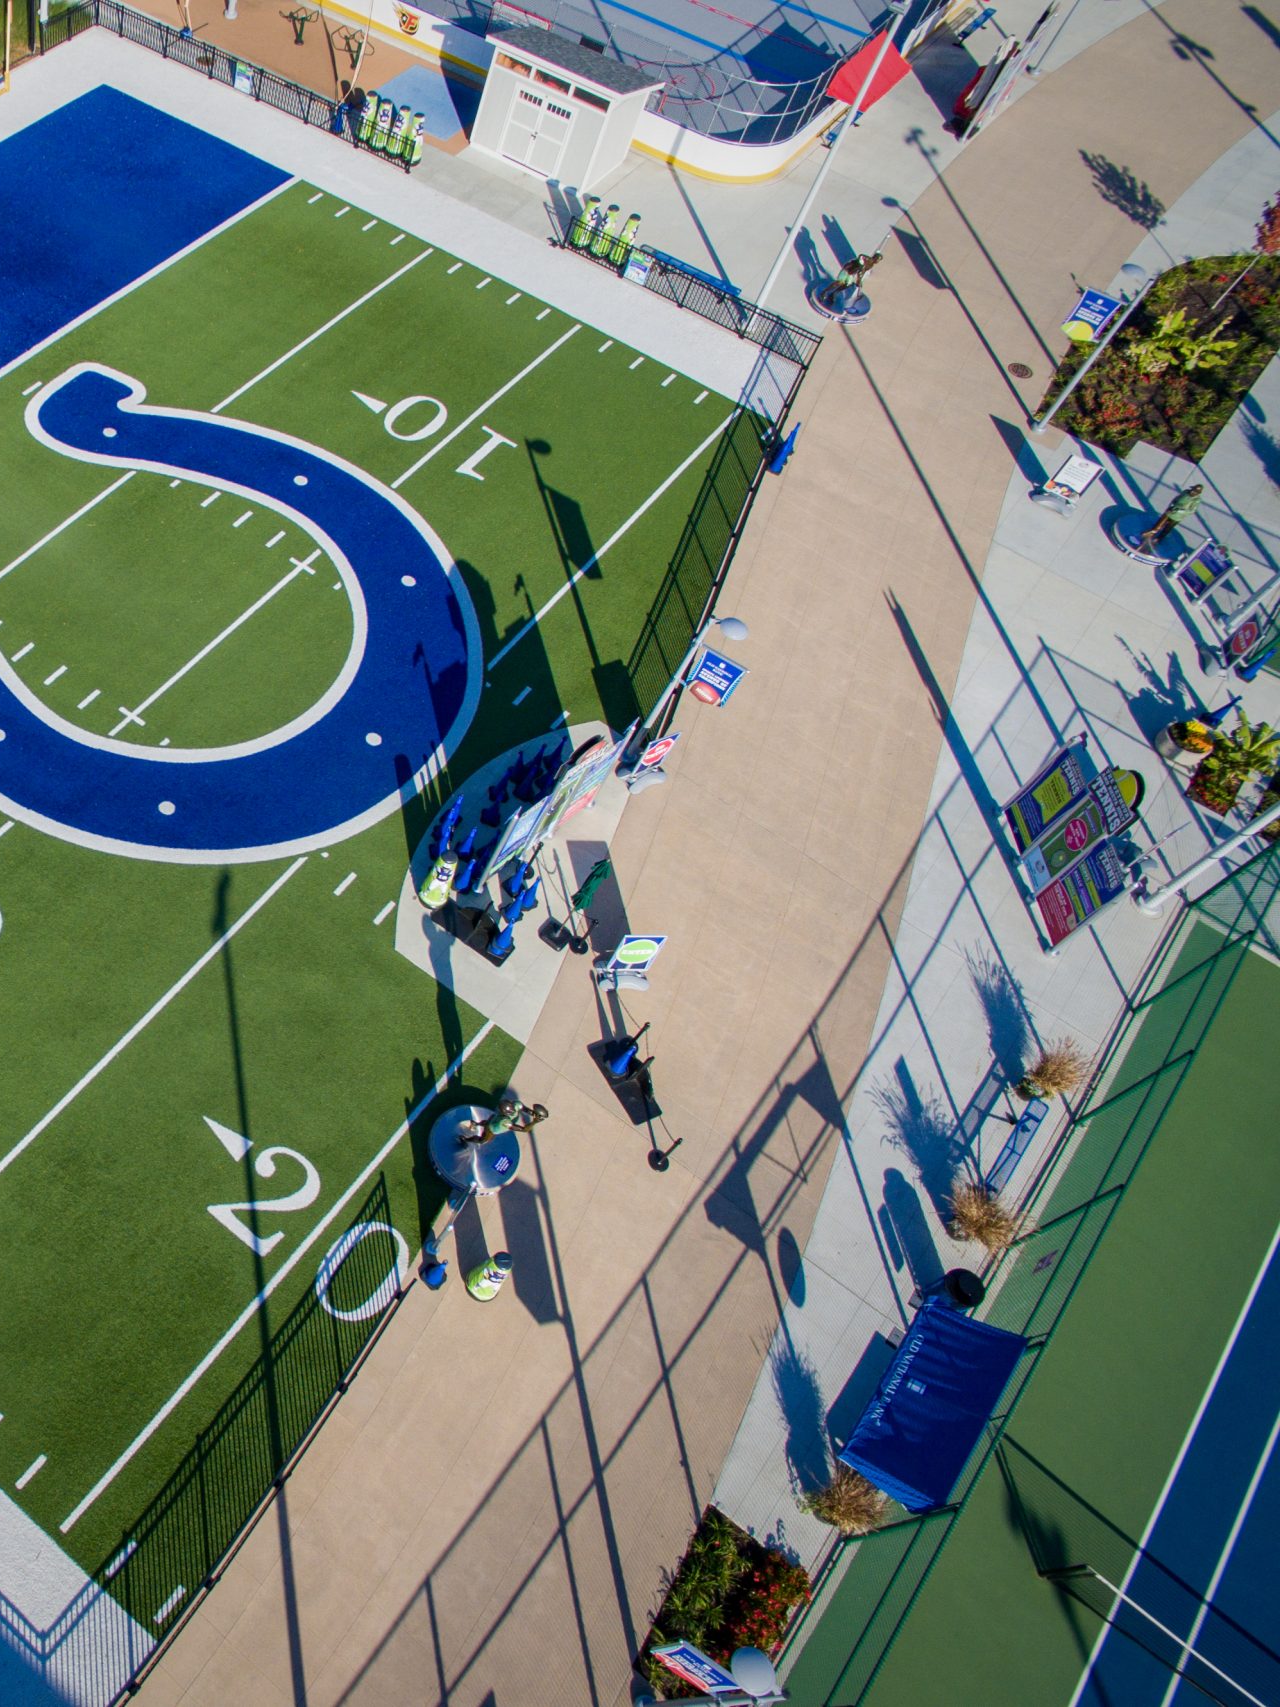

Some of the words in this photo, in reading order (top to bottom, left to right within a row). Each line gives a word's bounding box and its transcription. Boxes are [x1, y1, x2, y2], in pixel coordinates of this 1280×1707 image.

[384, 395, 518, 481] 10
[1091, 775, 1120, 832] TENNIS
[1098, 850, 1118, 889] TENNIS
[206, 1146, 410, 1322] 20
[909, 1334, 925, 1353] OLD
[884, 1354, 916, 1395] NATIONAL
[870, 1396, 892, 1420] BANK
